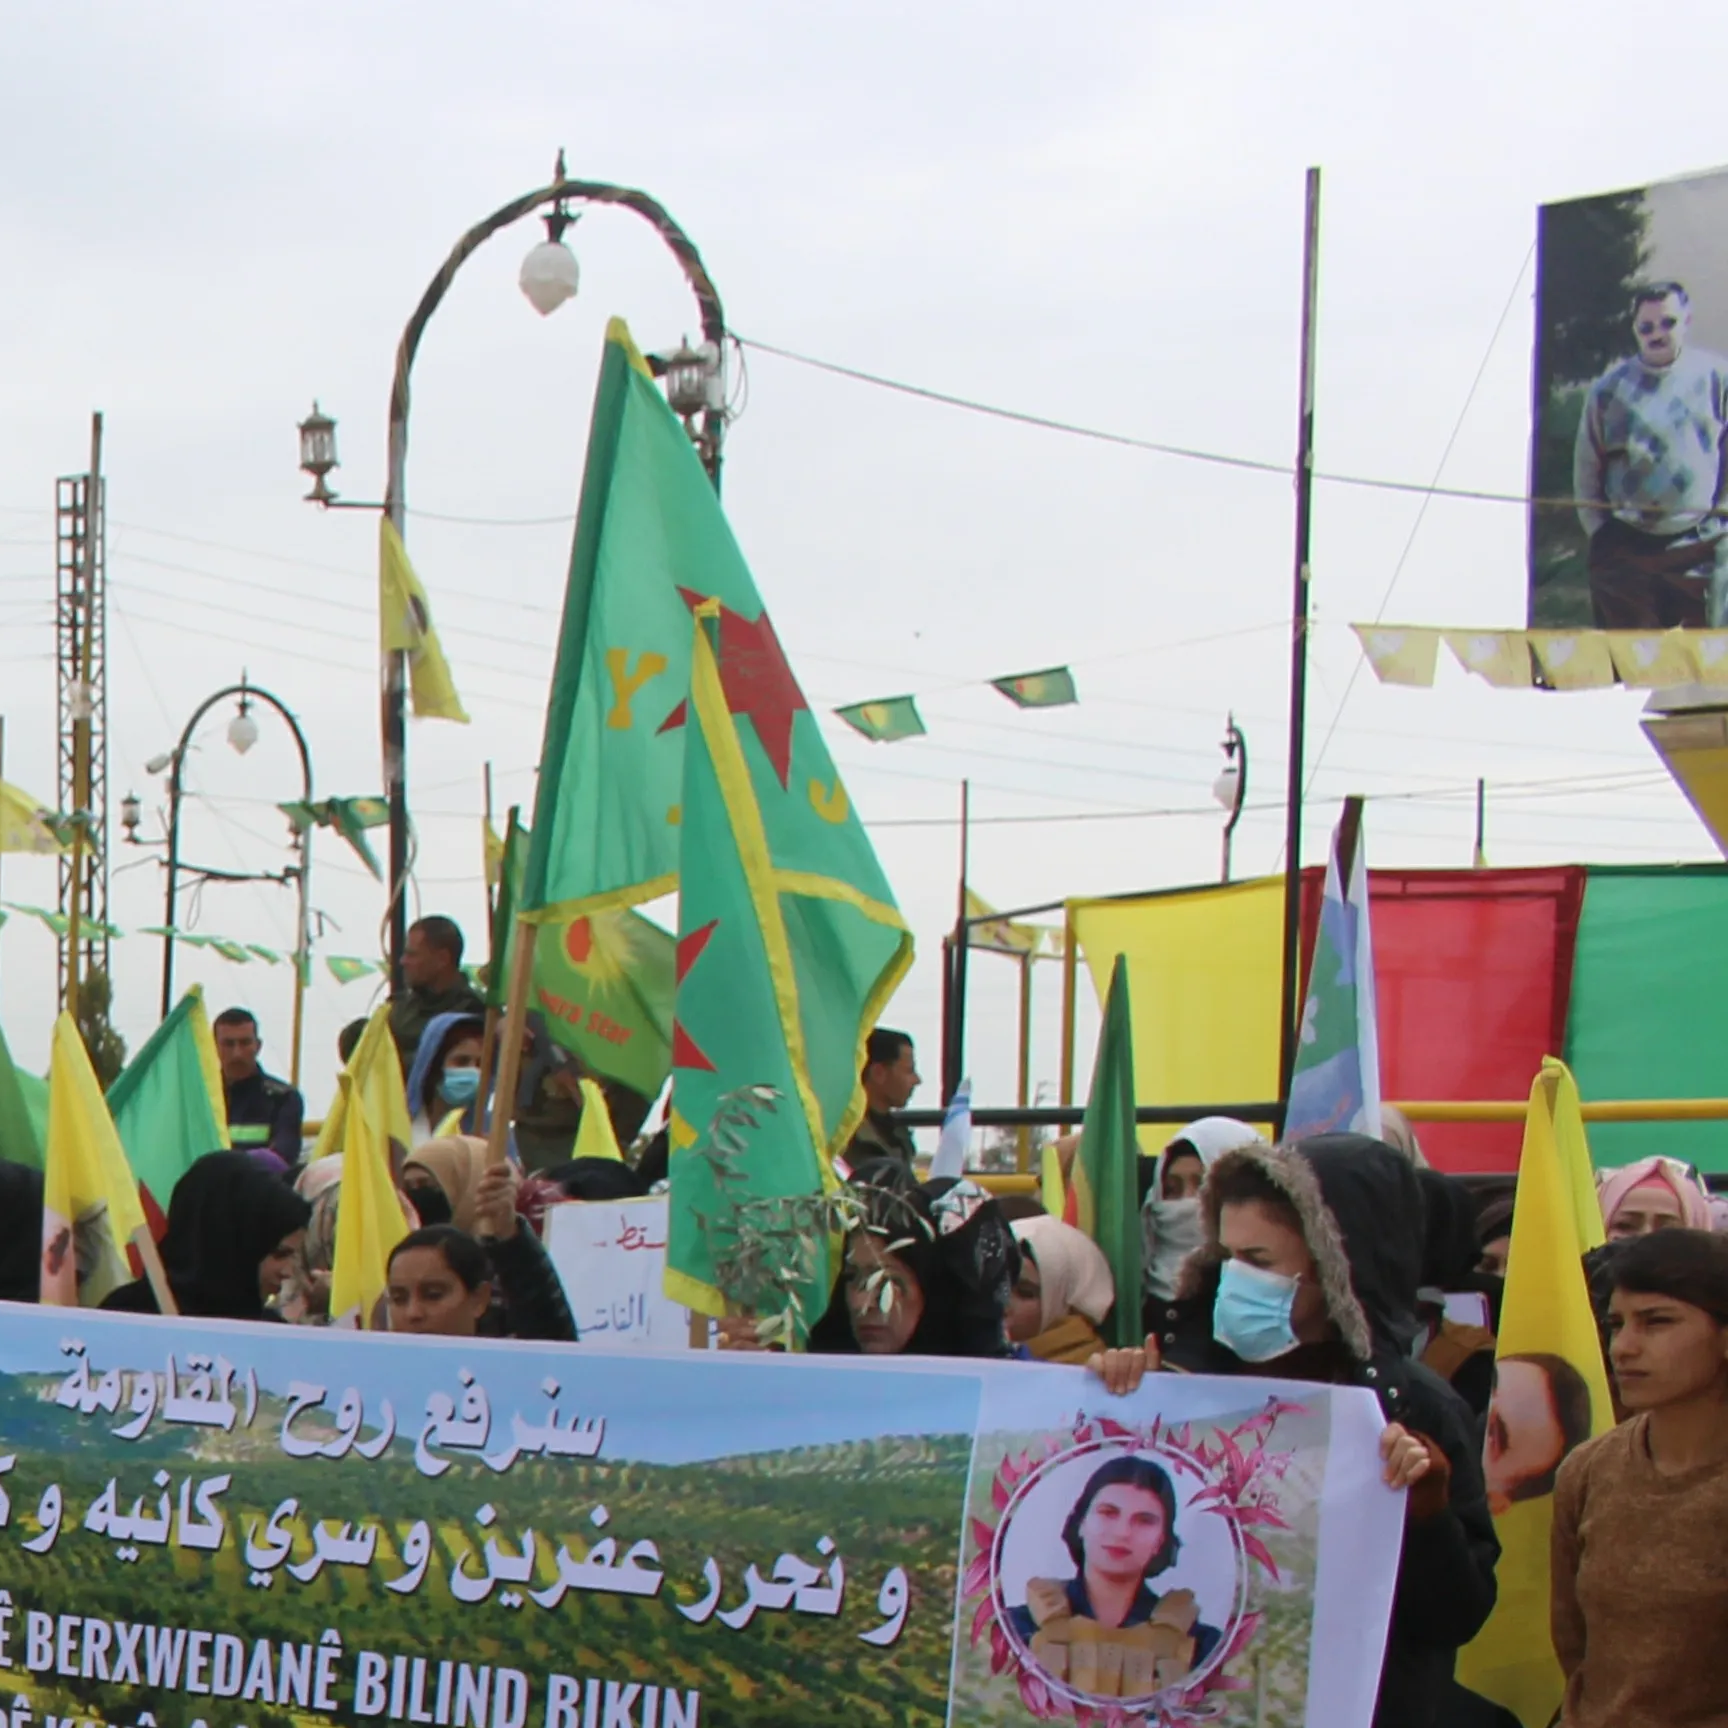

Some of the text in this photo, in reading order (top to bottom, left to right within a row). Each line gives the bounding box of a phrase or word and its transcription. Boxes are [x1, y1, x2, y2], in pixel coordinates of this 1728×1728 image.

[54, 1336, 606, 1478] سنرفع روح المقاومة
[452, 1502, 665, 1610] عفرين
[681, 1534, 846, 1631] نحرر
[26, 1610, 343, 1712] BERXWEDANÊ
